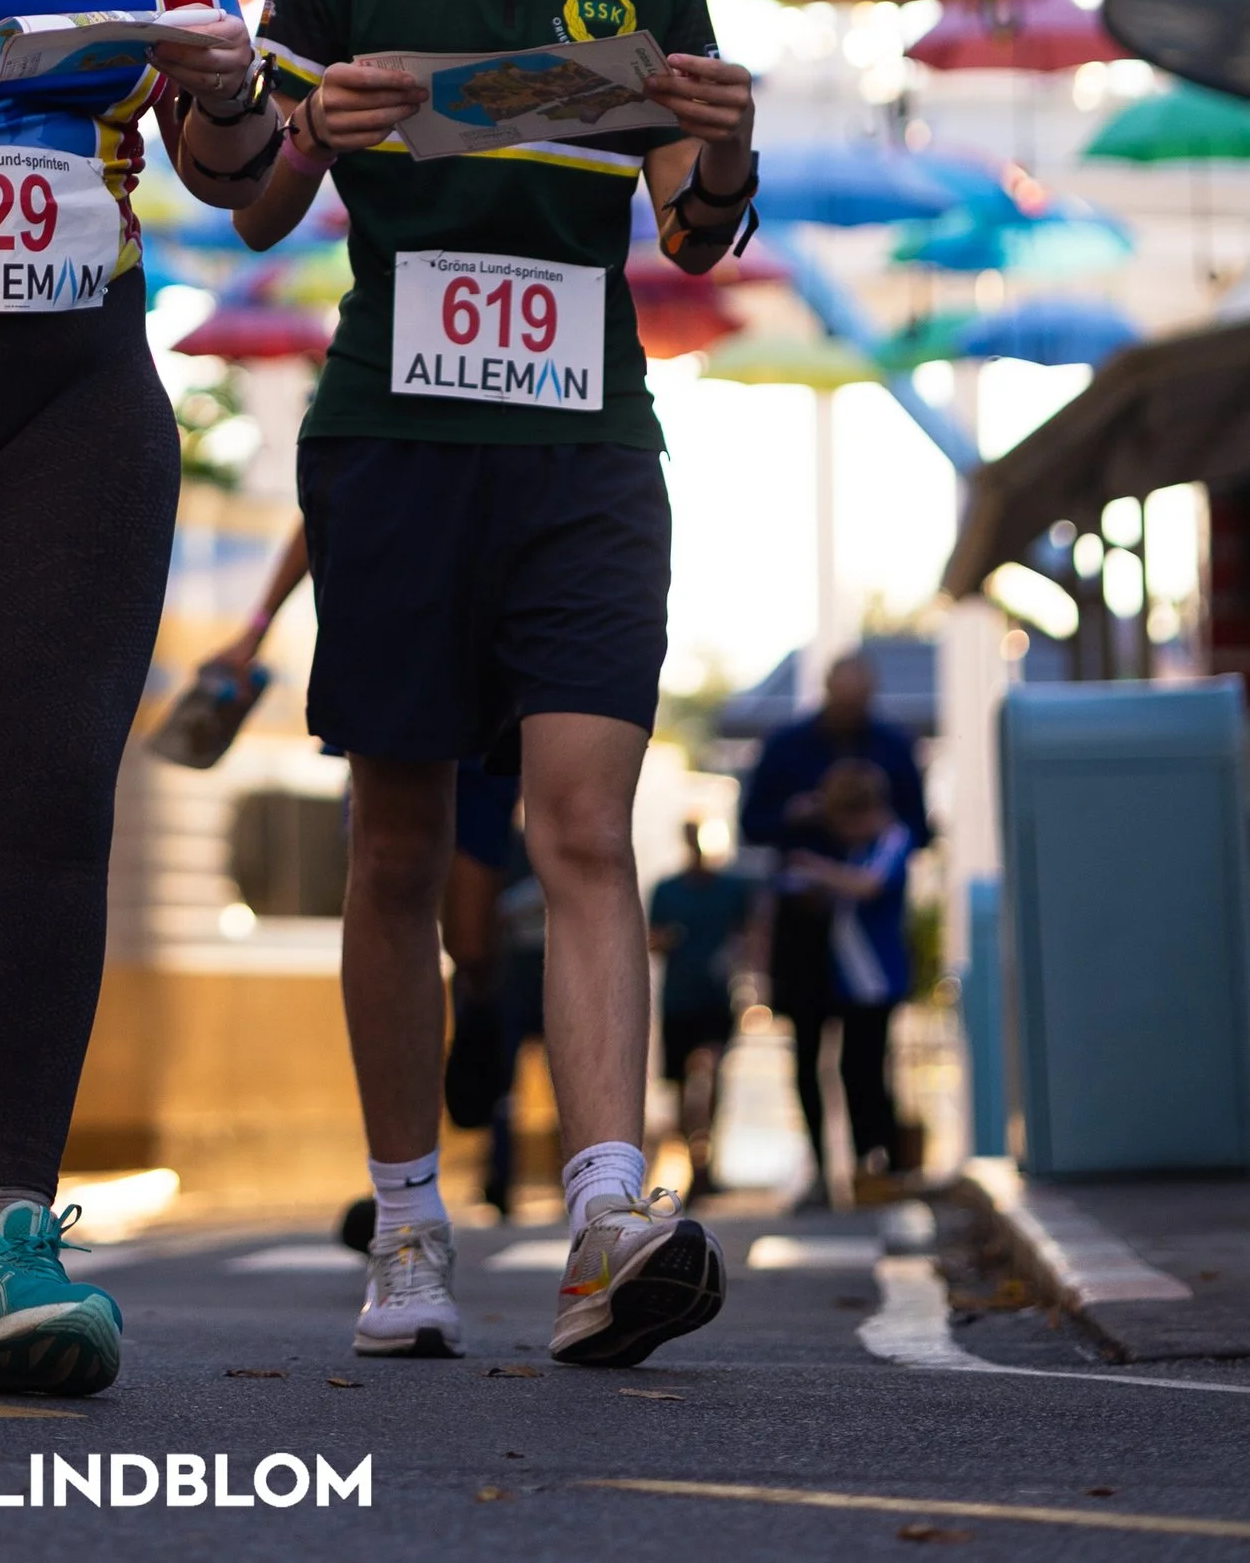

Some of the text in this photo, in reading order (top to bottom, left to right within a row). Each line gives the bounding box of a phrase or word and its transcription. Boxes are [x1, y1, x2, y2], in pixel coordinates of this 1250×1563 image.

[583, 0, 623, 25] SSK
[438, 259, 563, 283] Gröna Lund-sprinten
[442, 276, 557, 353] 619
